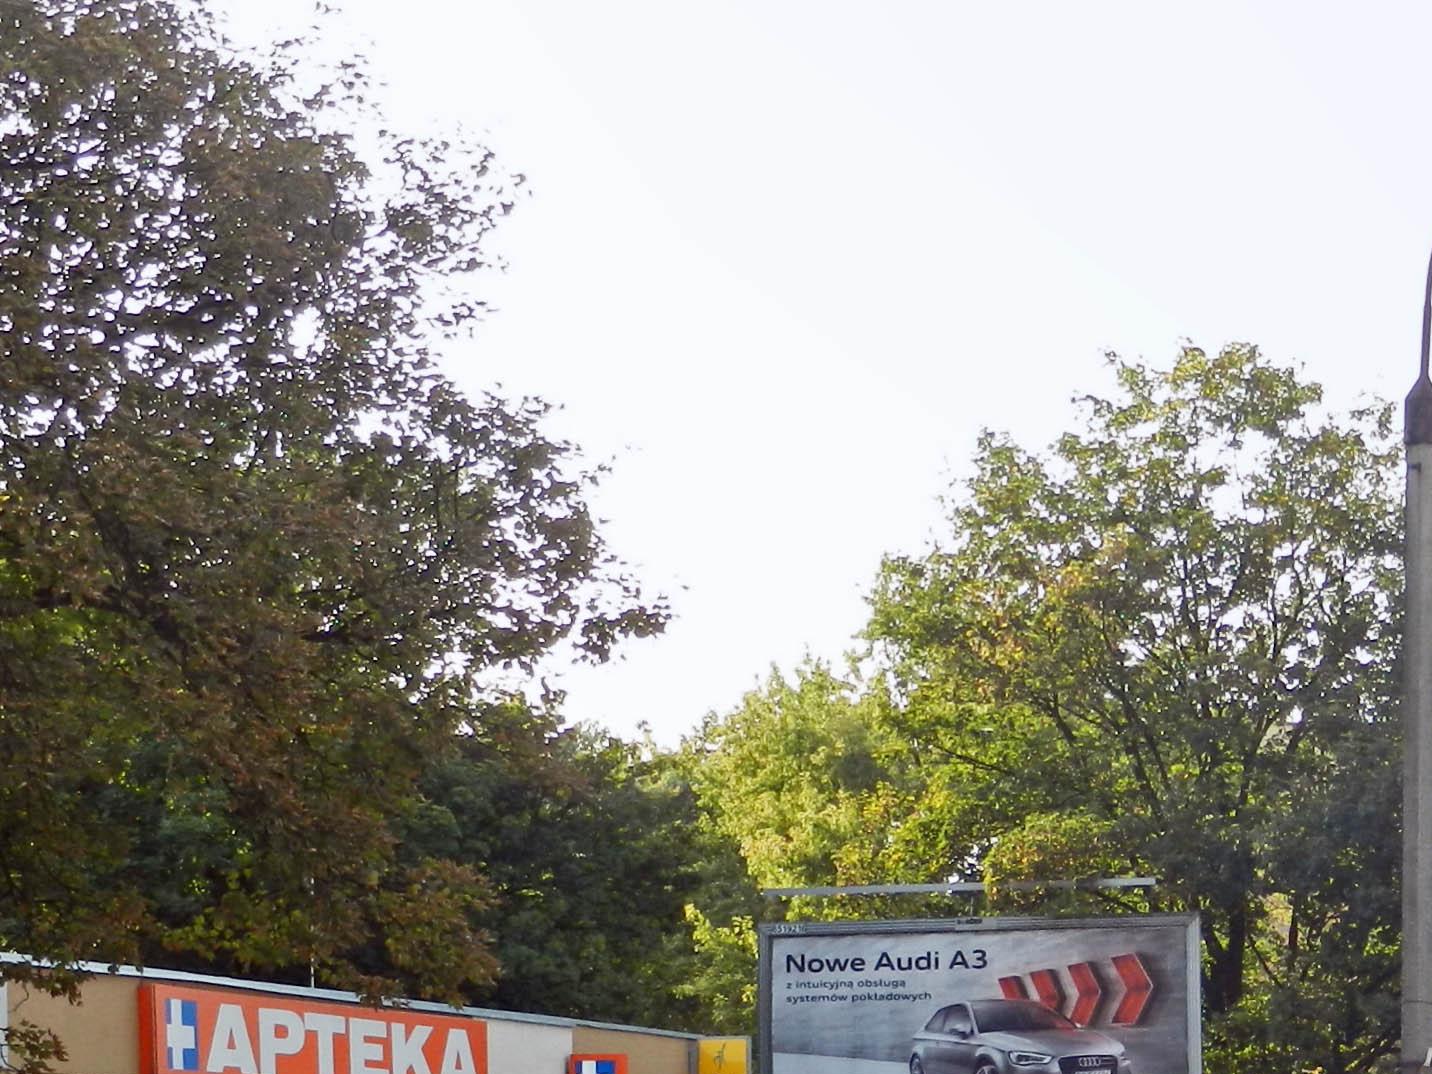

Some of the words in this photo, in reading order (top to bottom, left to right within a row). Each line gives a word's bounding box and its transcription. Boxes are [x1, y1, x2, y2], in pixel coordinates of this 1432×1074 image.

[786, 953, 866, 973] Nowe
[874, 951, 939, 971] Audi
[949, 949, 988, 969] A3
[786, 981, 793, 989] z
[796, 979, 853, 990] intuicyjną
[857, 979, 906, 989] obsługą
[786, 993, 848, 1005] systemów
[851, 991, 932, 1003] pokładowych
